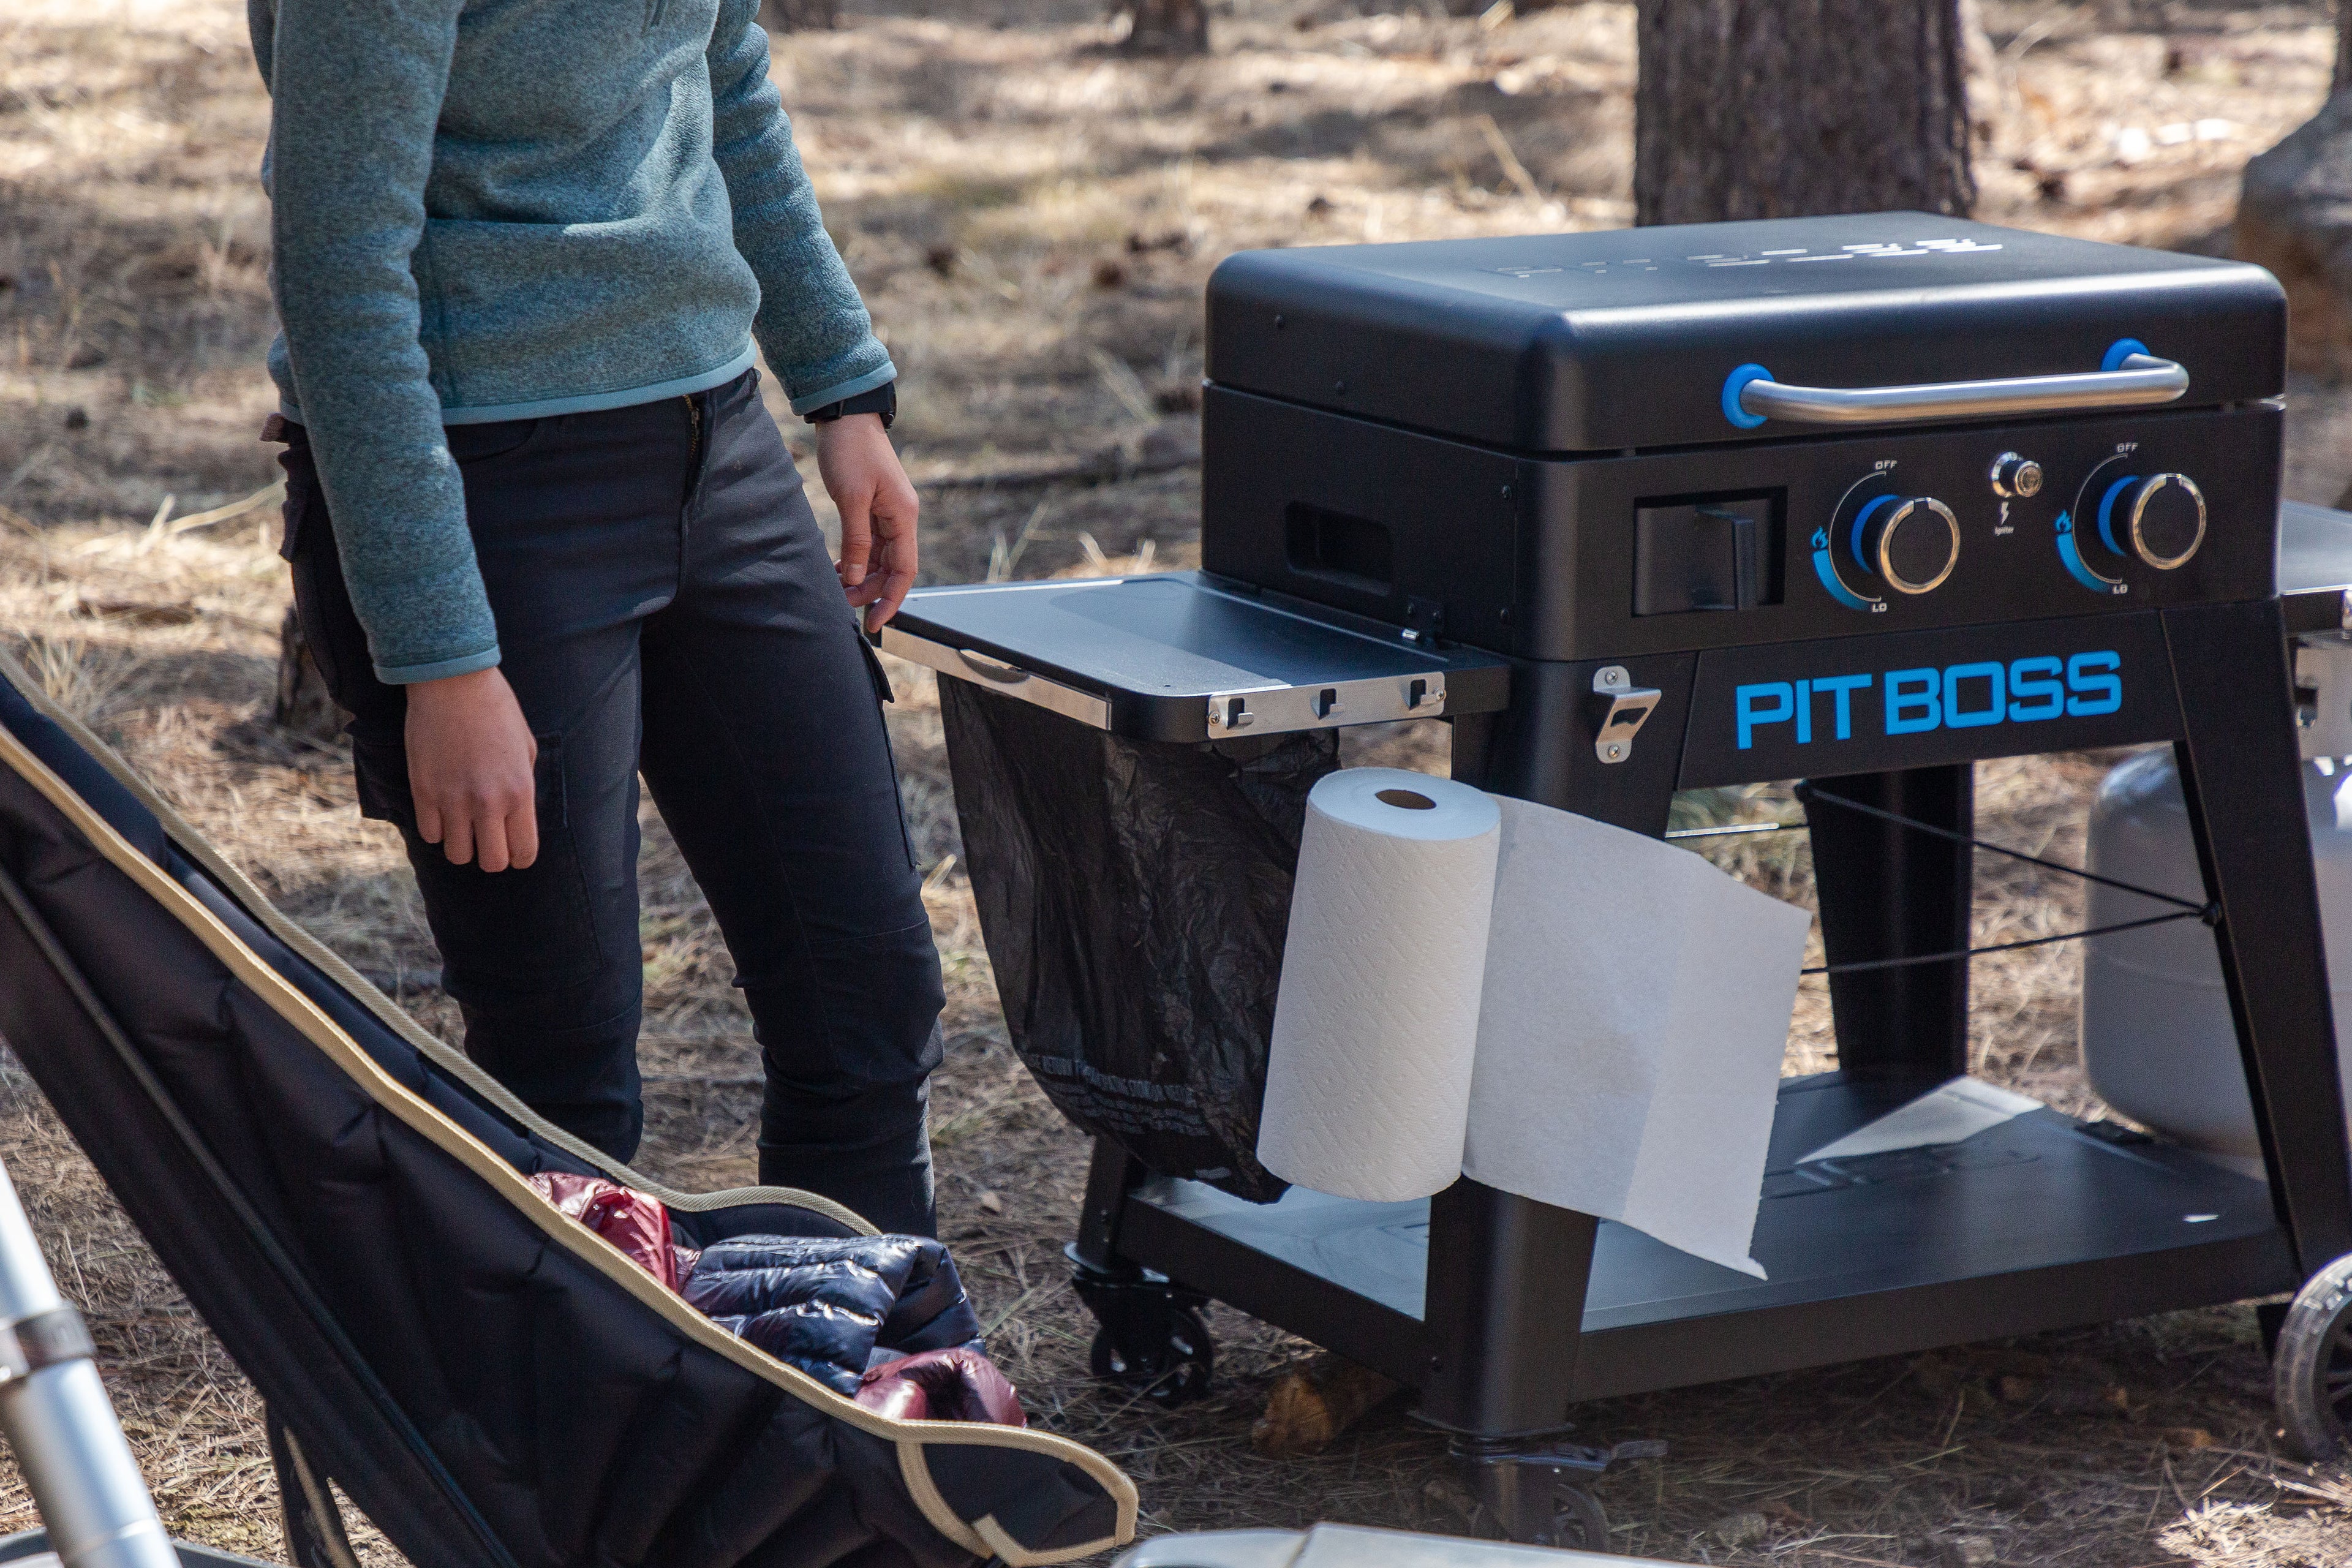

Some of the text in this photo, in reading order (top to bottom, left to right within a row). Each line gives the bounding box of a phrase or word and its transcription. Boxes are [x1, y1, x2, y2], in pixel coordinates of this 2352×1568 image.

[2117, 442, 2138, 453] OFF
[1875, 460, 1898, 470] OFF
[2113, 584, 2128, 594] LO
[1872, 602, 1887, 612] LO
[1736, 650, 2122, 750] PIT BOSS
